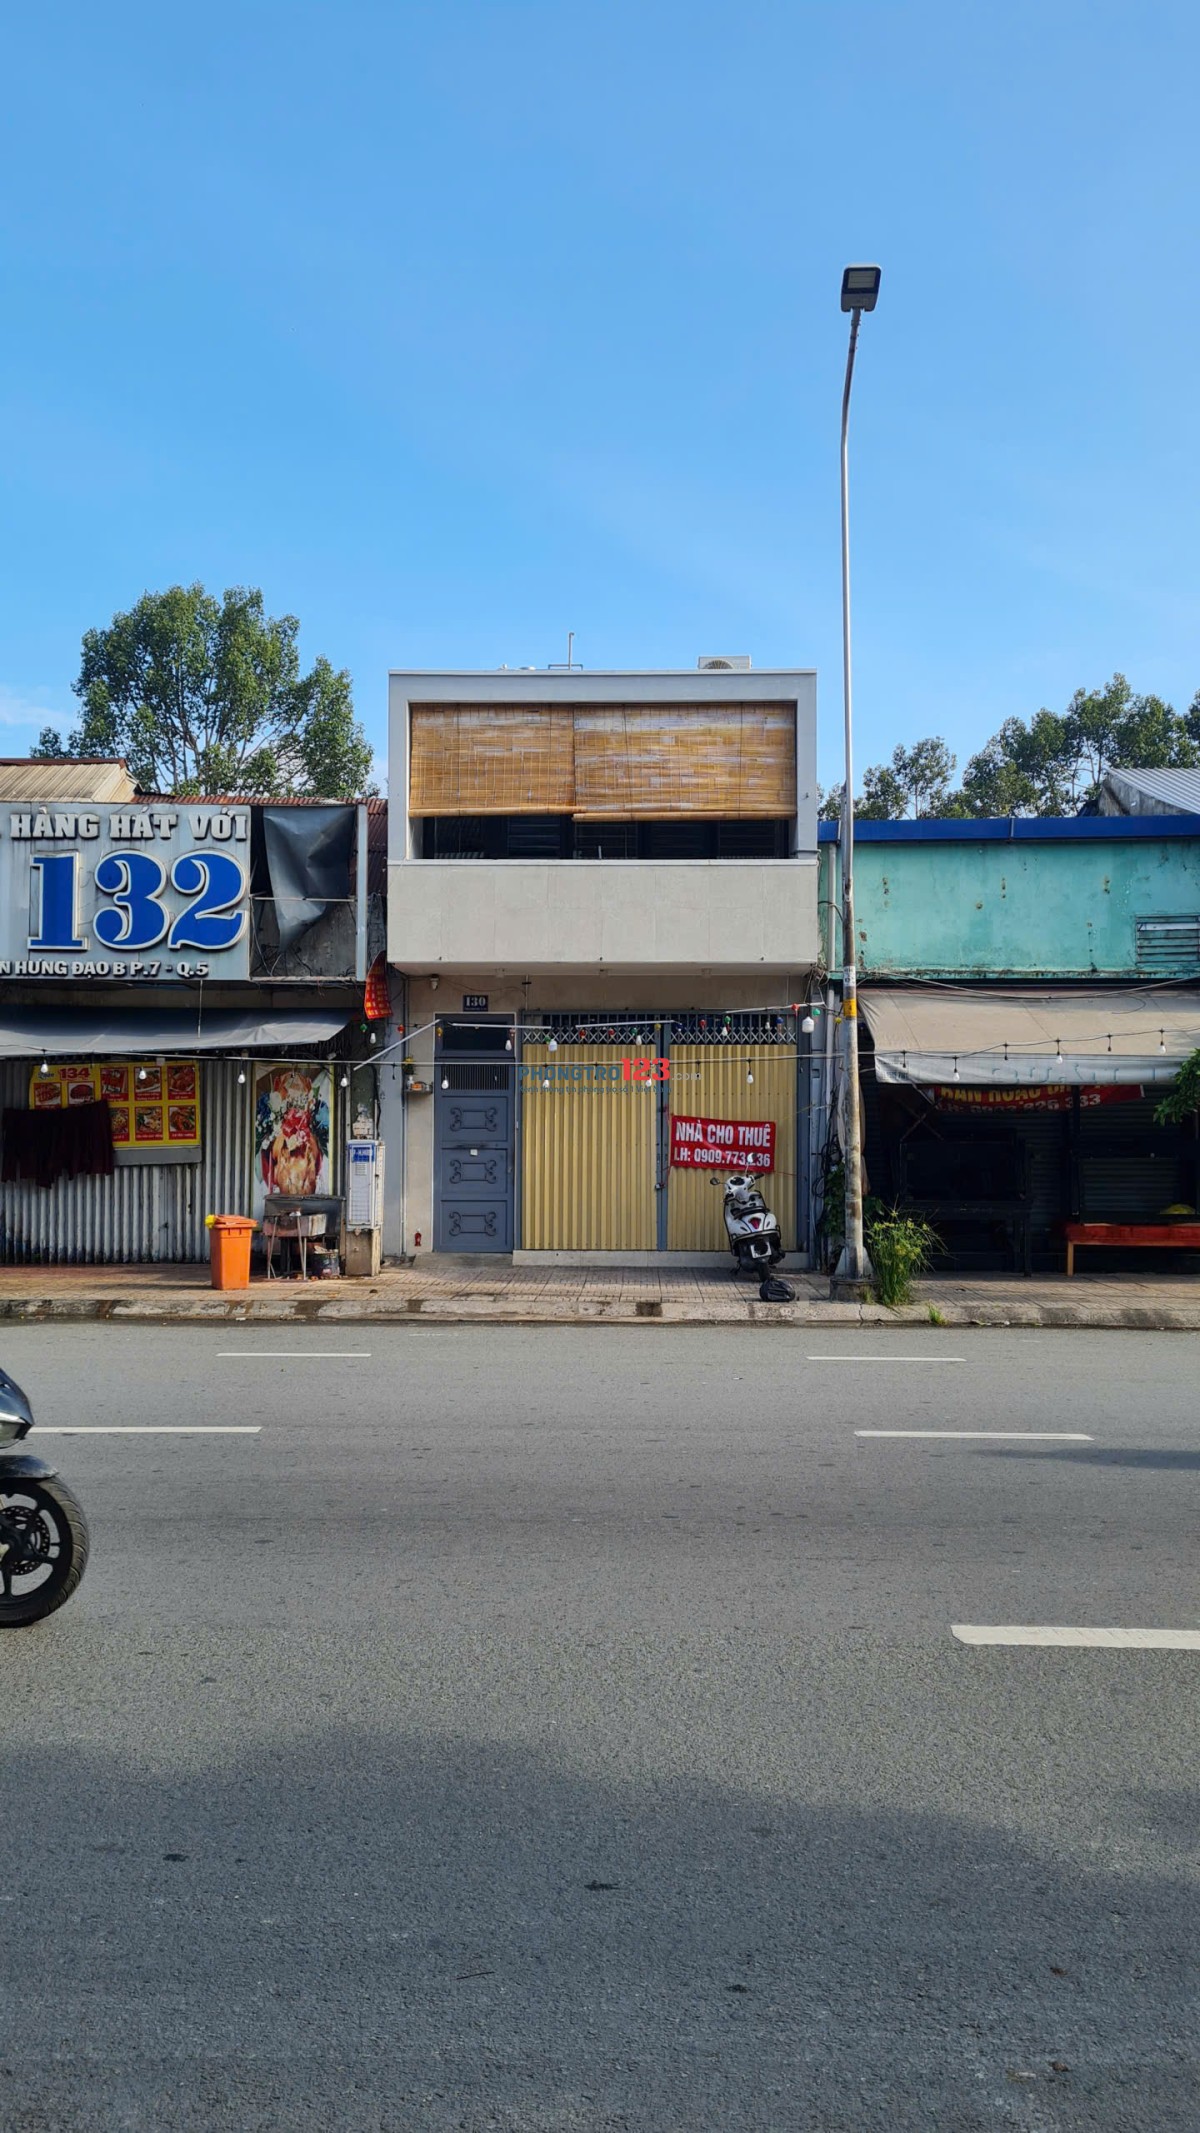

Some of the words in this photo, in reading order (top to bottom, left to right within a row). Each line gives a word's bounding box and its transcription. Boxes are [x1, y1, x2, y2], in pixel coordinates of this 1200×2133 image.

[188, 807, 247, 839] VỚI
[27, 850, 249, 950] 132
[71, 961, 109, 979] ĐẠO
[112, 961, 125, 976] B
[176, 961, 209, 978] Q.5
[466, 996, 486, 1007] 130
[59, 1067, 90, 1079] 134
[675, 1120, 703, 1143] NHÀ
[707, 1124, 734, 1145] CHO
[738, 1123, 771, 1148] THUÊ
[674, 1147, 691, 1162] LH:
